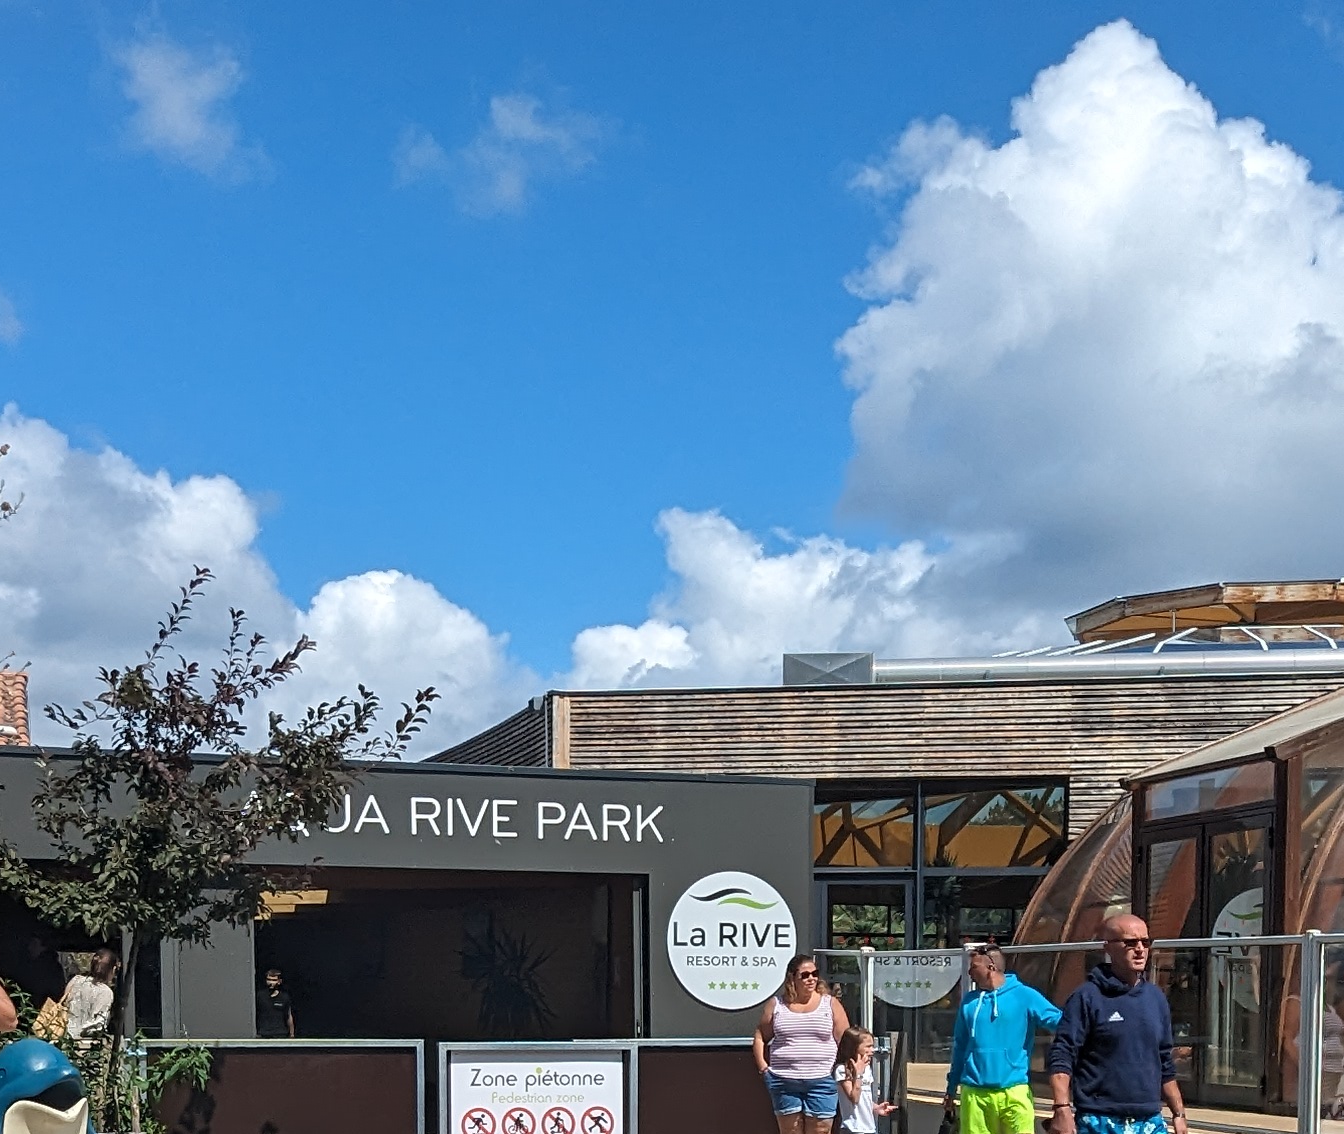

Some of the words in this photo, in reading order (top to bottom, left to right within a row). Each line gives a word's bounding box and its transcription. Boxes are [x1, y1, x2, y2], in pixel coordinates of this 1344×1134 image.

[410, 796, 518, 838] RIVE
[537, 802, 665, 843] PARK
[673, 921, 706, 947] La
[718, 922, 791, 948] RIVE
[686, 955, 738, 967] RESORT
[740, 955, 749, 967] &
[752, 956, 777, 967] SPA
[470, 1068, 518, 1087] Zone
[525, 1067, 605, 1093] piétonne
[491, 1092, 552, 1104] Pedestrian
[556, 1094, 584, 1103] zone
